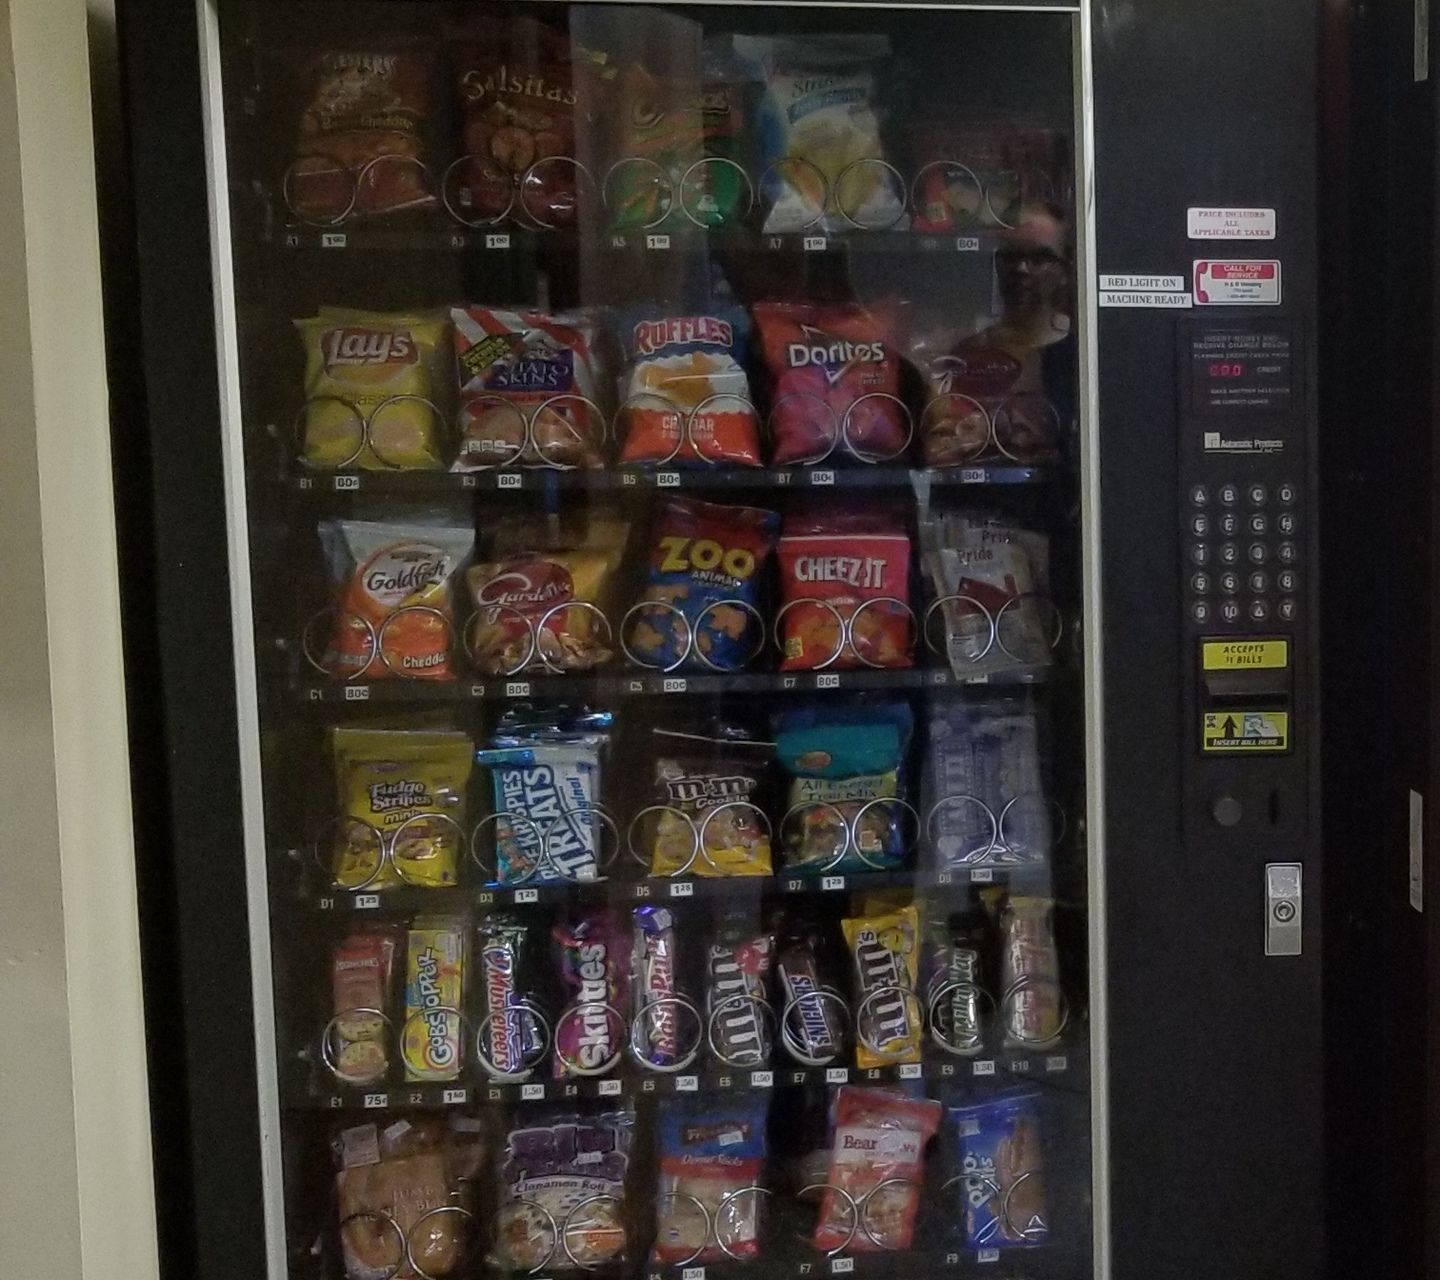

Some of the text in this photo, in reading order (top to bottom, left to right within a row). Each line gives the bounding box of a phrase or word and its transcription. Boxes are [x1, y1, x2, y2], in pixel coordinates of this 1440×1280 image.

[461, 65, 579, 104] Salsitas
[1108, 278, 1176, 287] RED LIGHT ON
[1107, 295, 1187, 305] MACHINE READY
[634, 316, 733, 355] RUFFLES
[788, 339, 885, 368] Doritos
[497, 373, 558, 387] SKINS
[1195, 490, 1205, 502] A
[1224, 490, 1234, 502] B
[1252, 489, 1263, 501] C
[1282, 489, 1291, 501] D
[1196, 519, 1205, 532] E
[1253, 519, 1263, 530] G
[1282, 518, 1292, 530] H
[659, 536, 755, 579] ZOO
[956, 548, 993, 565] Pride
[1197, 549, 1203, 560] 1
[1226, 549, 1234, 560] 2
[1254, 547, 1262, 559] 3
[1283, 547, 1291, 559] 4
[1197, 577, 1205, 590] 5
[1226, 577, 1233, 588] 6
[1283, 575, 1291, 588] 8
[1197, 606, 1205, 617] 9
[1225, 606, 1237, 618] 10
[1223, 645, 1264, 654] ACCEPTS
[1236, 656, 1263, 664] BILLS
[1213, 738, 1240, 746] INSERT
[369, 779, 425, 797] Fudge
[523, 765, 595, 874] TREATS
[636, 886, 650, 897] D5
[320, 898, 334, 909] D1
[480, 893, 493, 904] D3
[790, 975, 832, 1047] SNICKERS
[794, 1073, 806, 1083] E7
[331, 1096, 342, 1107] E1
[843, 1134, 879, 1151] Bear
[515, 1180, 578, 1194] Cinnamon
